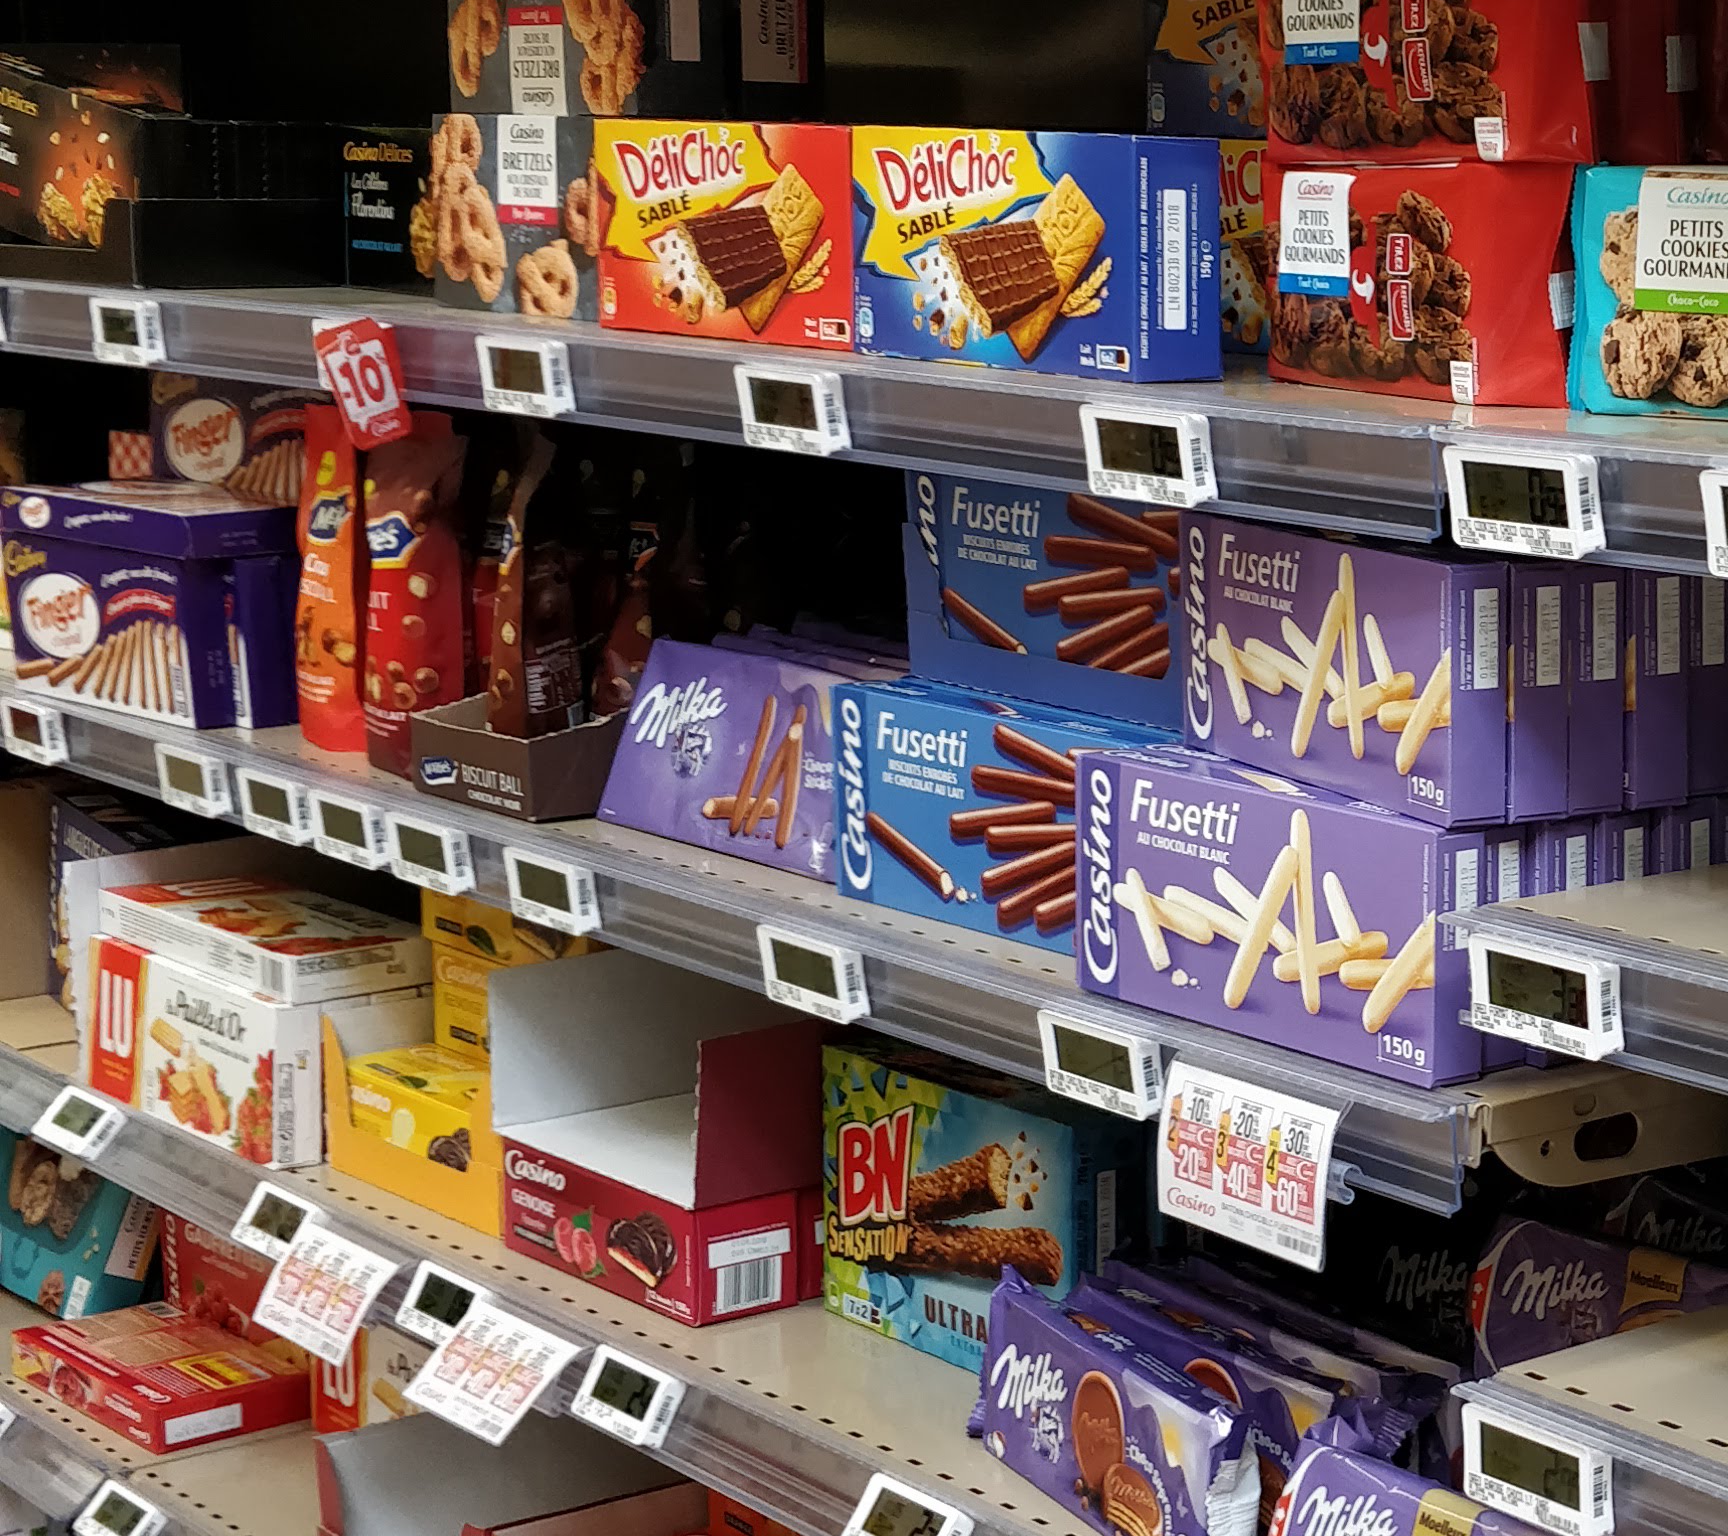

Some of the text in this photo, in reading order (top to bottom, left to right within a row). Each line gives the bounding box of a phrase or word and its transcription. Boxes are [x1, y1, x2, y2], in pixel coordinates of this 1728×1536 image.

[1286, 11, 1356, 33] GOURMANDS
[510, 122, 545, 142] Casino
[502, 150, 554, 172] BRETZELS
[613, 128, 746, 200] DéliChoc
[874, 142, 1017, 214] DéliChoc
[637, 191, 692, 229] SABLÉ
[896, 206, 957, 244] SABLÉ
[1669, 218, 1724, 240] PETITS
[1667, 291, 1720, 308] Choco-Coco
[952, 486, 1041, 540] Fusetti
[1217, 533, 1302, 595] Fusetti
[630, 677, 728, 747] Milka
[875, 710, 968, 768] Fusetti
[461, 763, 525, 797] BISCUIT BALL
[1129, 777, 1243, 845] Fusetti
[1136, 831, 1231, 866] AU CHOCOLAT BLANC
[97, 959, 134, 1052] LU
[504, 1150, 567, 1192] Casino
[839, 1106, 914, 1222] BN
[1502, 1261, 1609, 1321] Milka
[923, 1293, 988, 1343] ULTRA
